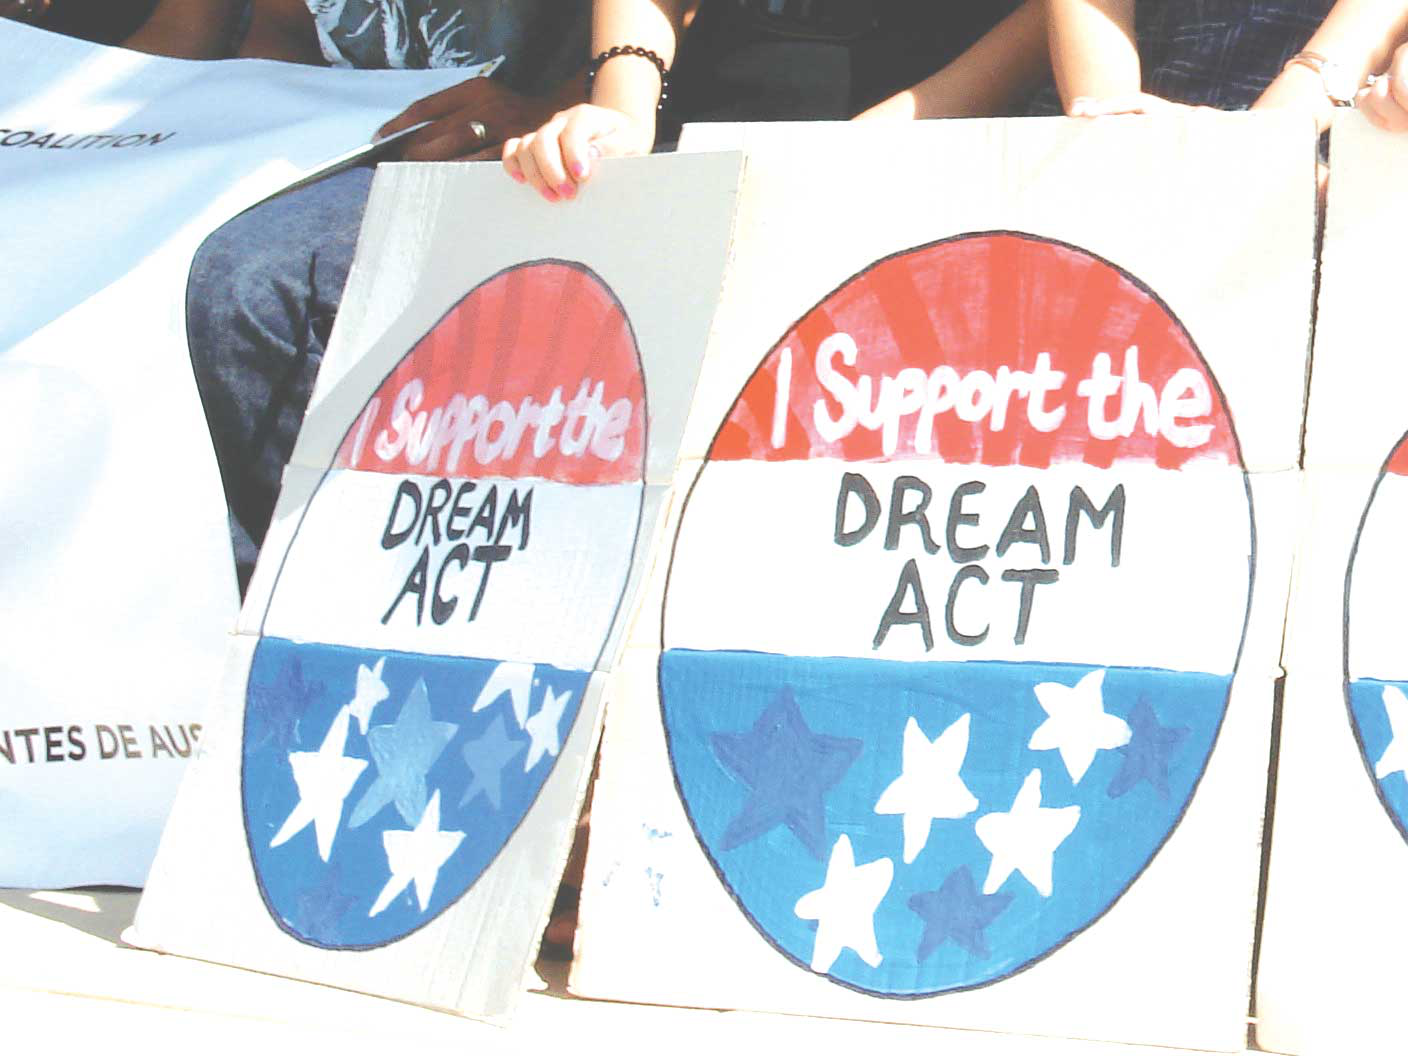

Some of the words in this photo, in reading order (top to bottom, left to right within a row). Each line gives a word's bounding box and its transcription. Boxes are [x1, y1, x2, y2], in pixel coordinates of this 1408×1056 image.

[349, 397, 381, 468] I
[374, 378, 563, 473] Support
[561, 377, 632, 462] the
[773, 347, 792, 449] I
[813, 332, 1067, 456] Support
[1078, 345, 1215, 447] the
[380, 478, 534, 551] DREAM
[833, 471, 1126, 568] DREAM
[381, 542, 512, 627] ACT
[872, 558, 1060, 652] ACT
[96, 724, 142, 760] DE
